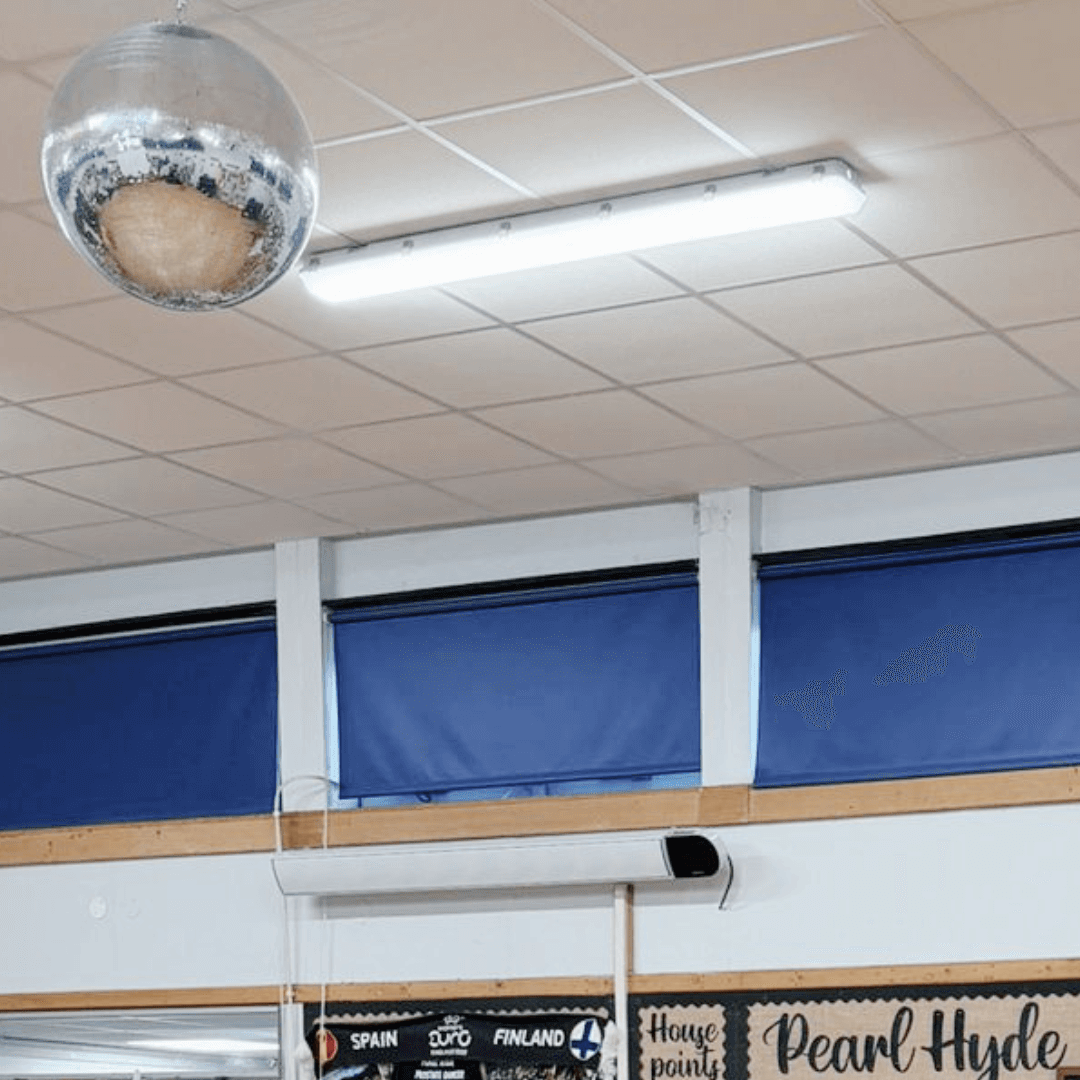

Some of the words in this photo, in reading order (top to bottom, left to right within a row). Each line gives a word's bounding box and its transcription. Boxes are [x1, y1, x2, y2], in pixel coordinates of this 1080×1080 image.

[350, 1029, 398, 1050] SPAIN
[493, 1028, 565, 1047] FINLAND
[646, 1013, 719, 1049] House
[762, 1006, 916, 1075] Pearl
